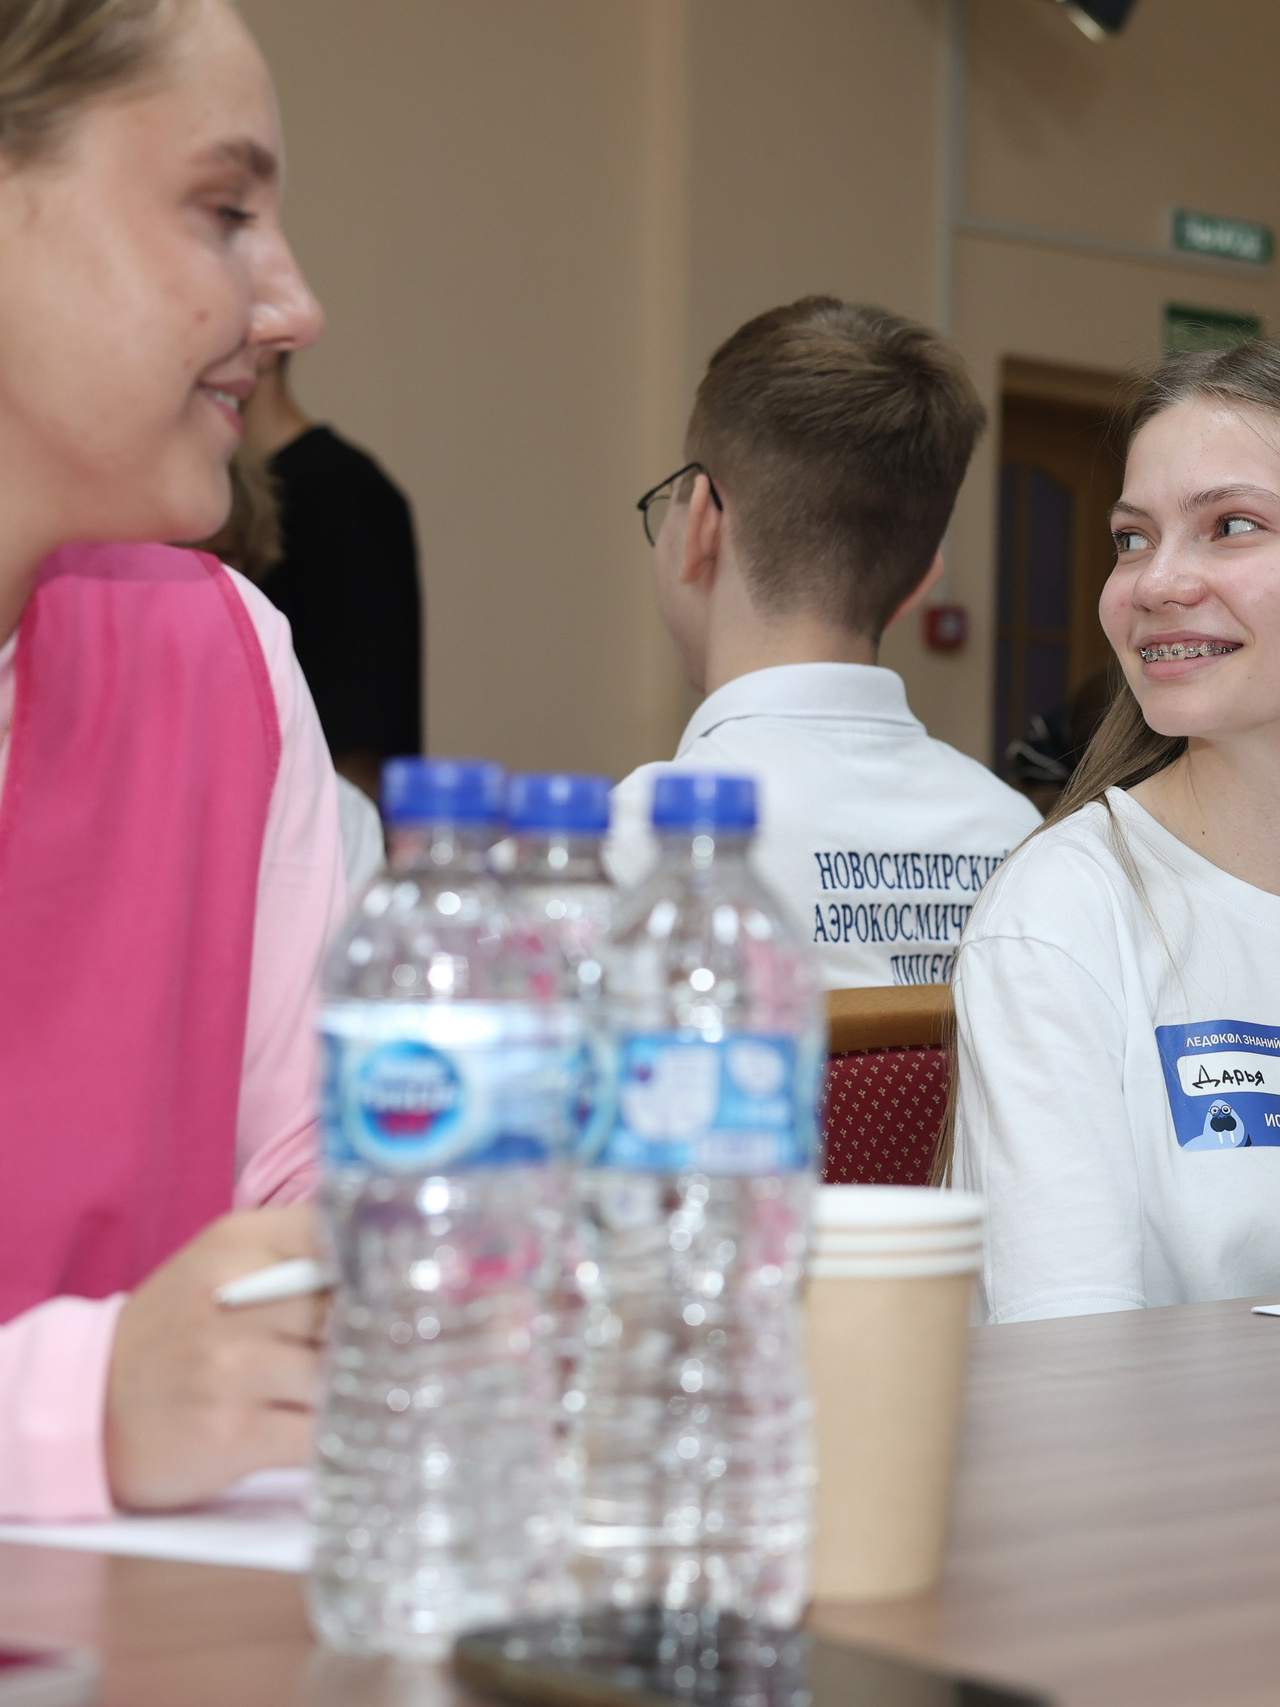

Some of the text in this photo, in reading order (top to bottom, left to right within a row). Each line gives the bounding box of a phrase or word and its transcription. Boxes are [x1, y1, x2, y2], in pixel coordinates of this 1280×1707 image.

[813, 849, 1010, 891] НОВОСИБИРСКИ
[1186, 1033, 1242, 1048] ЛЕДОКОЛ
[1243, 1034, 1280, 1049] ЗНАНИЙ
